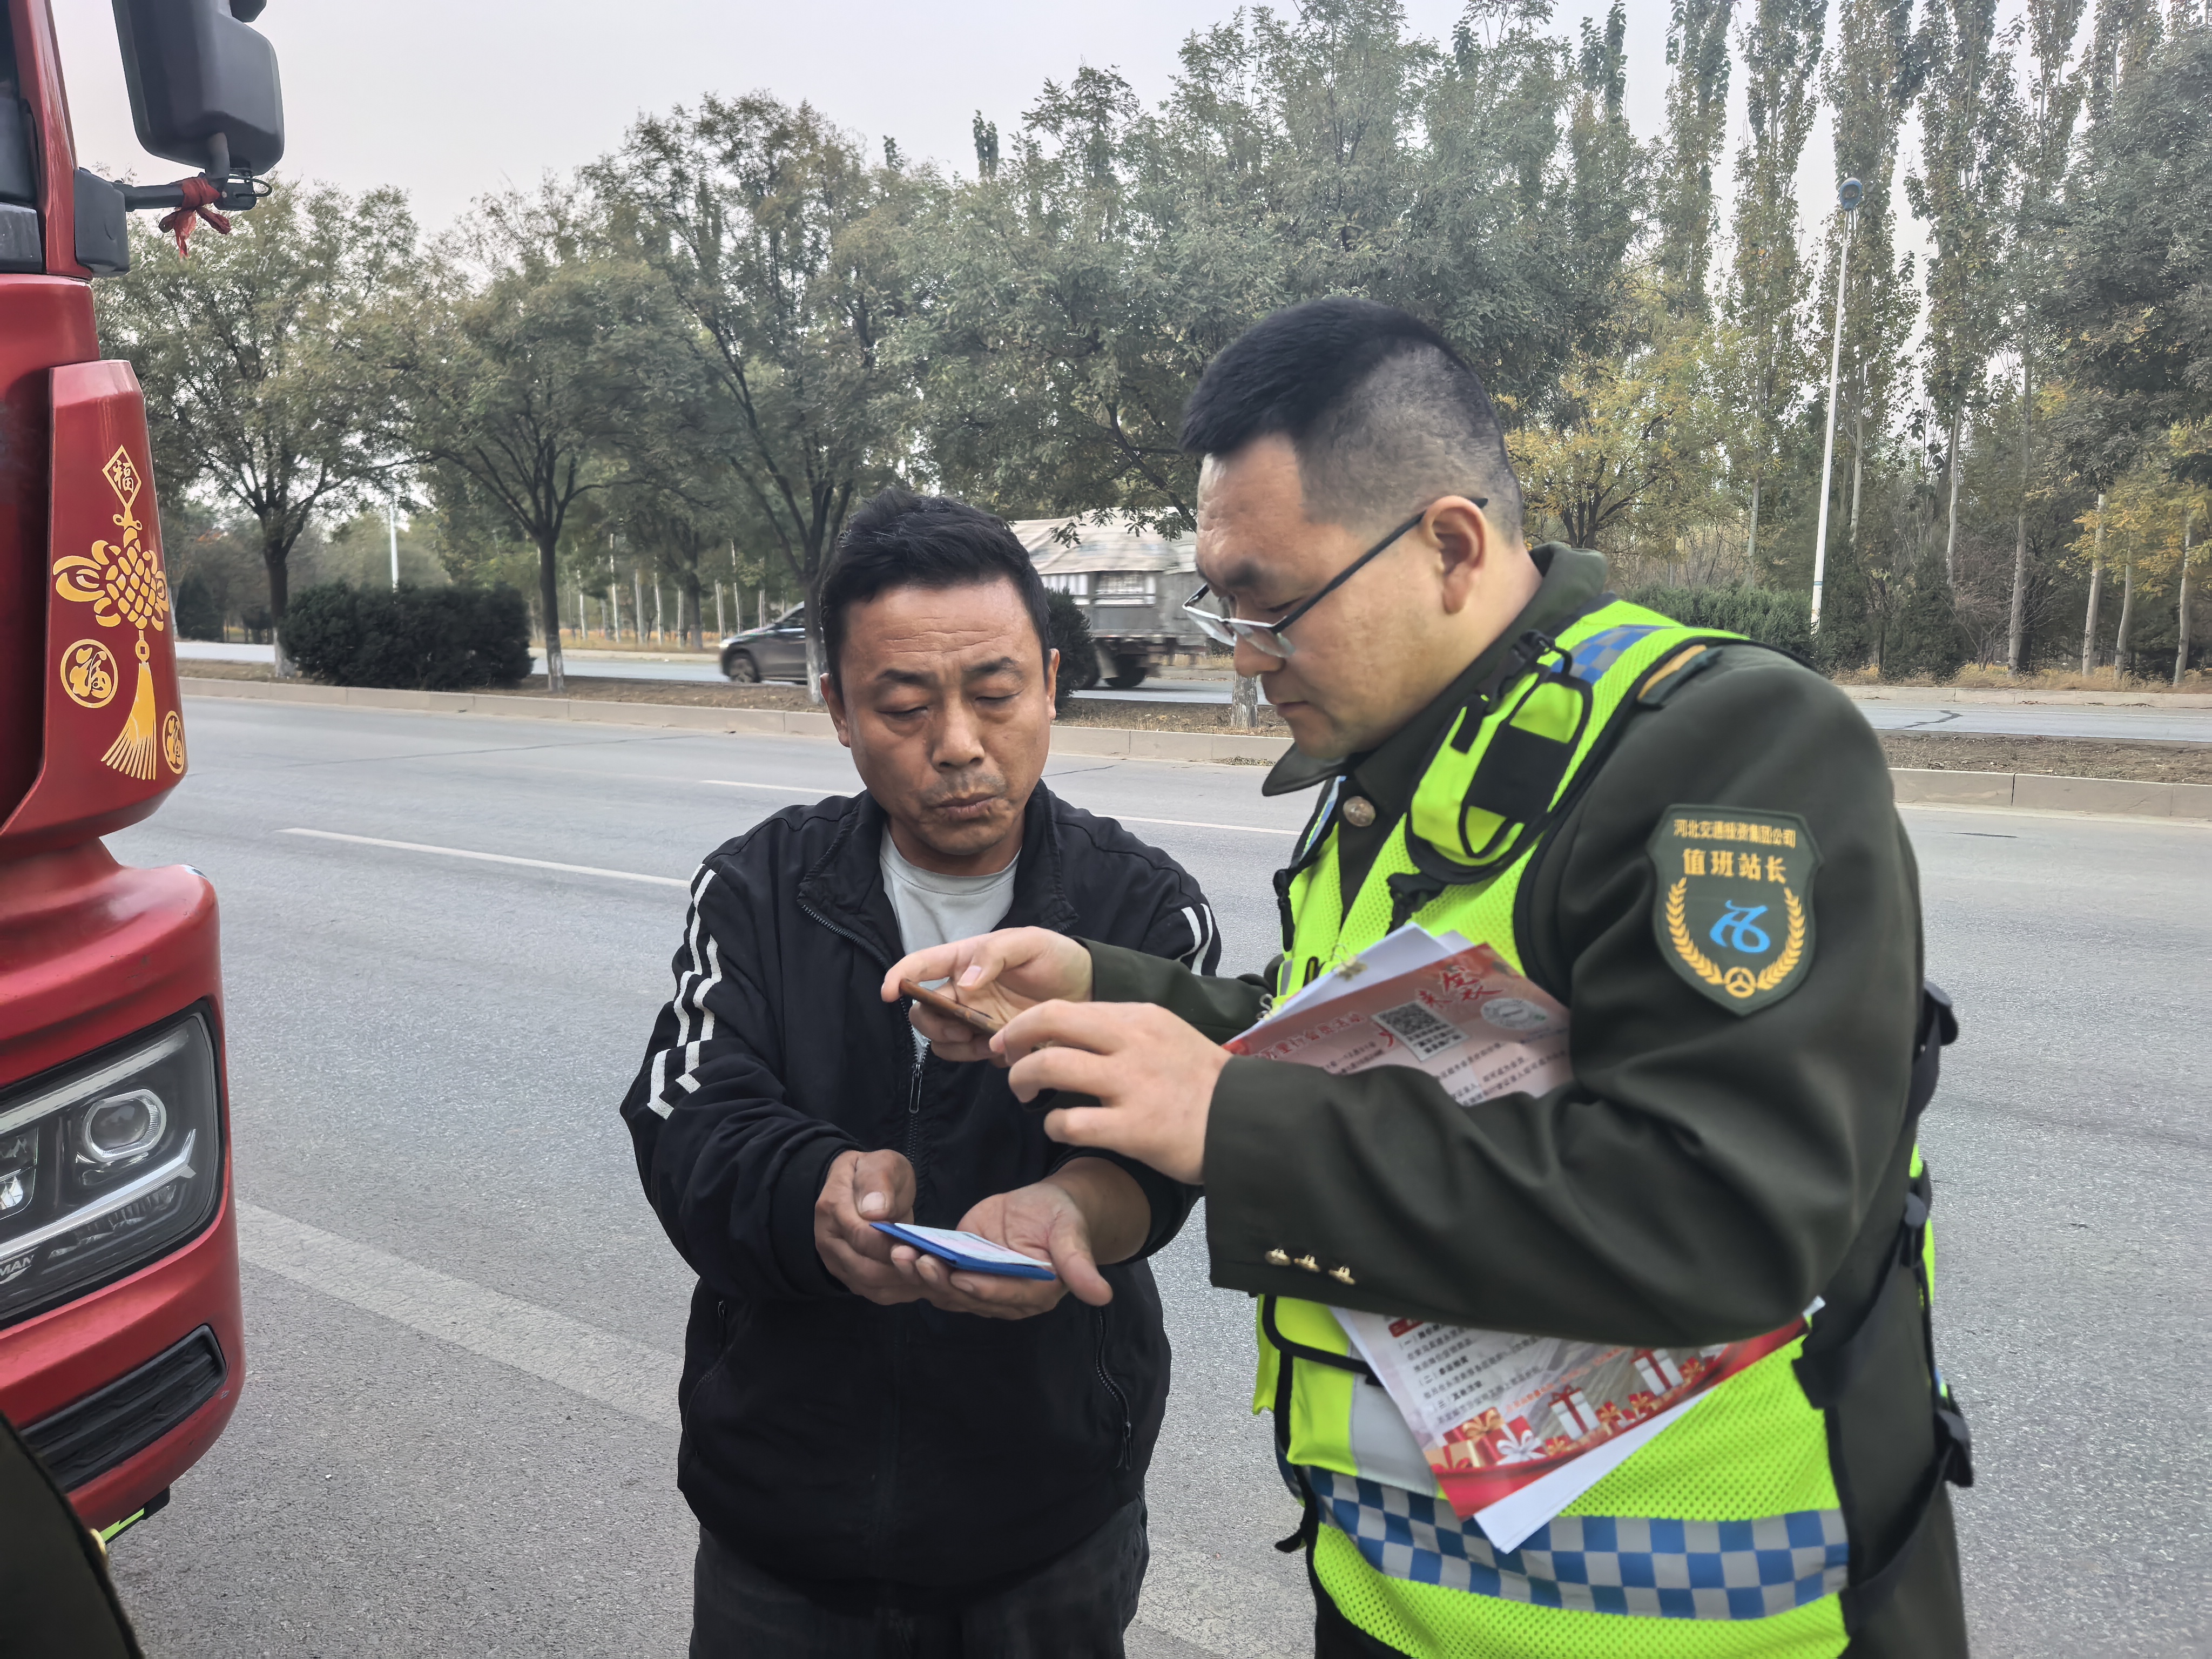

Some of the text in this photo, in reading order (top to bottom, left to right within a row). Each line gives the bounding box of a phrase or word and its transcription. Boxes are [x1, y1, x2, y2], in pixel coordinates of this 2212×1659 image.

[112, 459, 136, 493] 福
[1673, 819, 1796, 848] 河北交通投资集团公司
[1682, 847, 1787, 884] 值班站长
